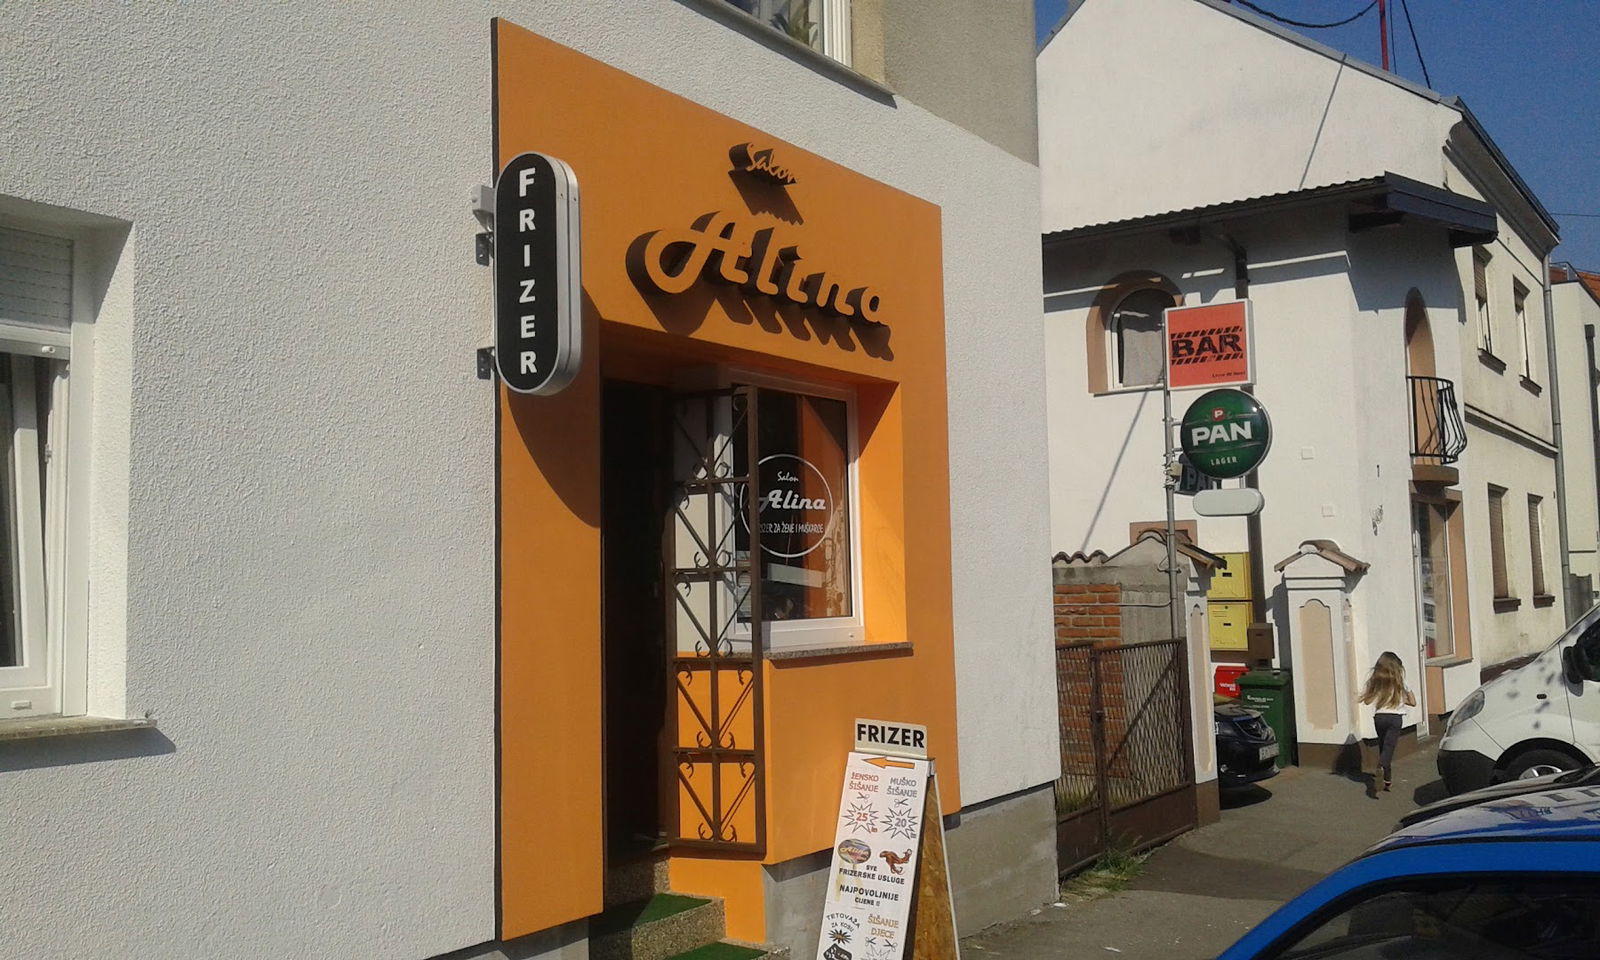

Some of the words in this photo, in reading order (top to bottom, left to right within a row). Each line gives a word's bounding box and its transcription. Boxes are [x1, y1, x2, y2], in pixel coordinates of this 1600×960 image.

[518, 166, 538, 375] FRIZER
[638, 211, 887, 325] Alina
[1171, 333, 1242, 358] BAR
[1191, 421, 1253, 446] PAN
[1210, 456, 1238, 466] LAGER
[759, 489, 827, 513] Alina
[856, 723, 925, 749] FRIZER
[850, 772, 879, 782] ŽENSKO
[890, 777, 917, 787] MUŠKO
[848, 780, 879, 793] ŠIŠANJE
[886, 785, 919, 798] ŠIŠANJE
[856, 812, 868, 822] 25
[894, 817, 907, 828] 20
[839, 867, 876, 880] FRIZERSKE
[877, 874, 905, 885] USLUGE
[839, 884, 900, 902] NAJPOVOLJNIJE
[854, 896, 874, 906] CIJENE
[826, 912, 861, 928] TETOVAŽA
[867, 913, 900, 929] ŠIŠANJE
[870, 927, 895, 940] DJECE
